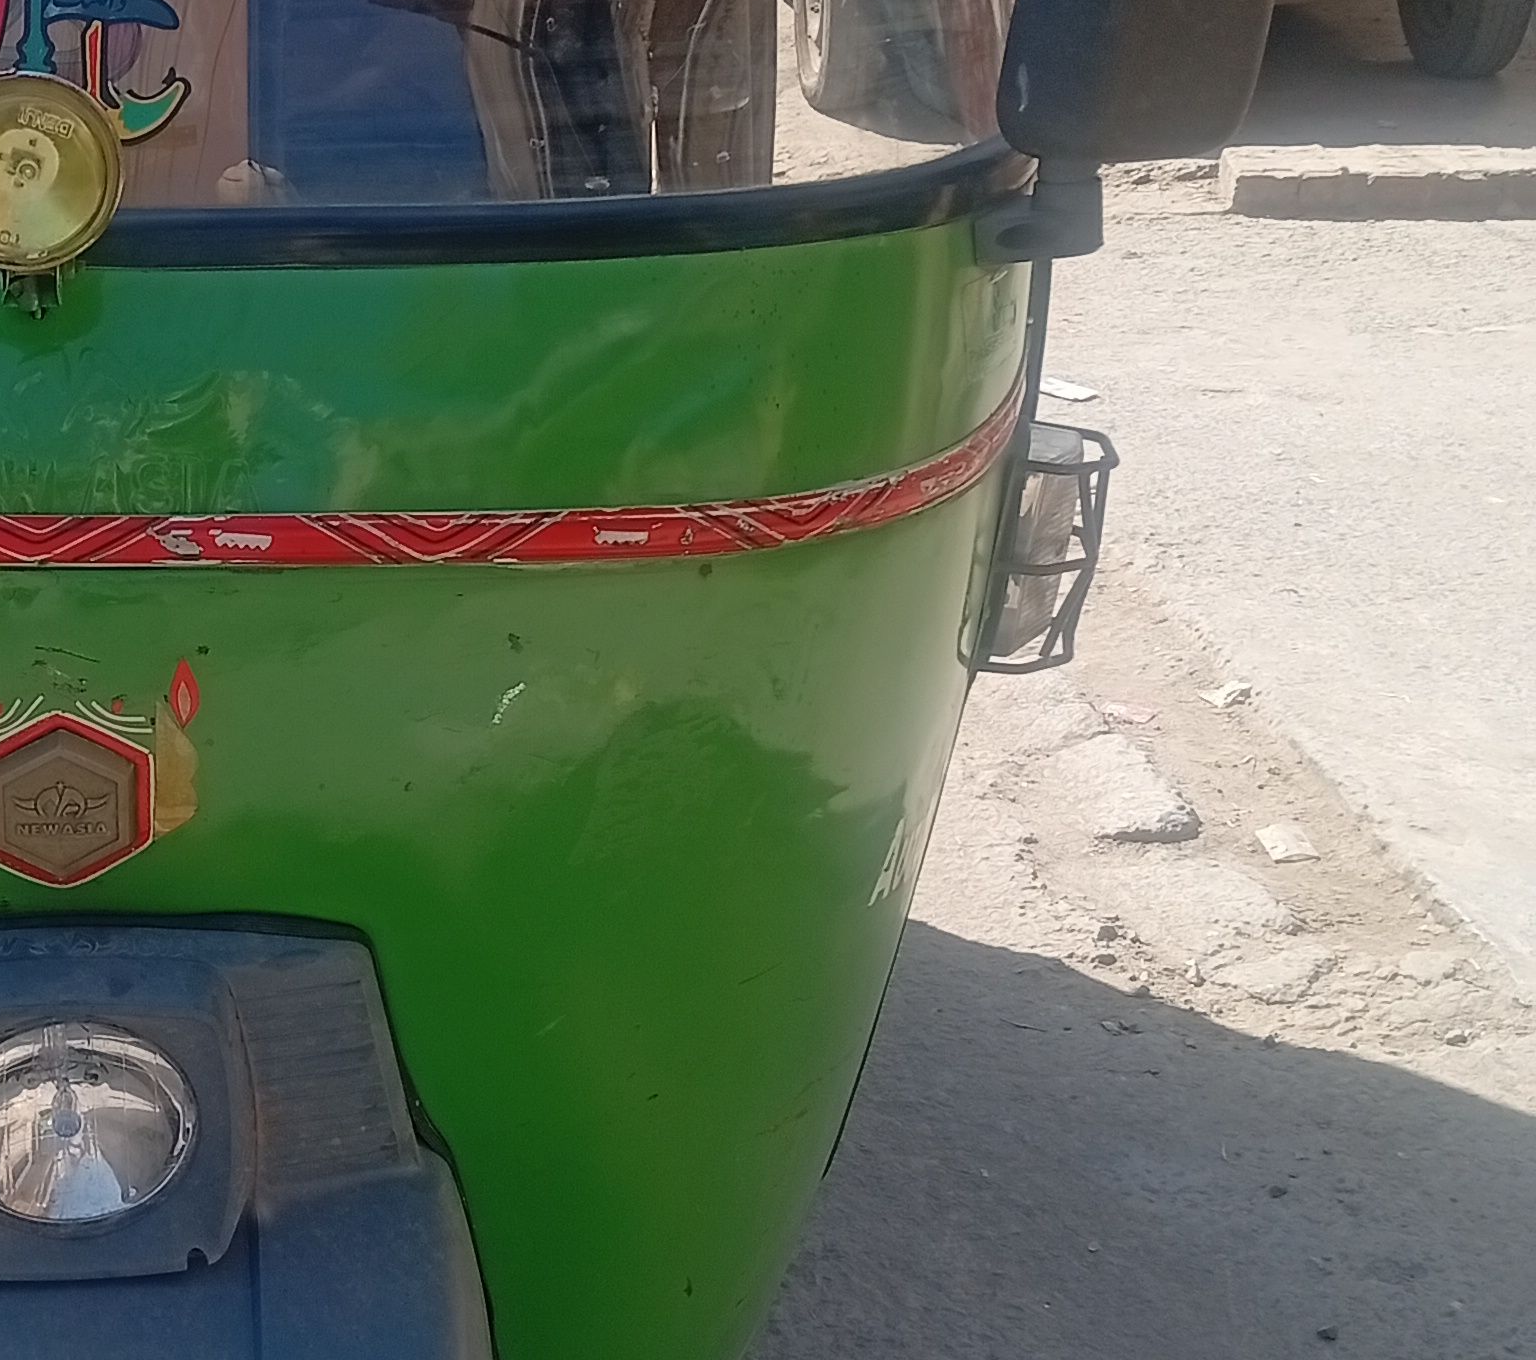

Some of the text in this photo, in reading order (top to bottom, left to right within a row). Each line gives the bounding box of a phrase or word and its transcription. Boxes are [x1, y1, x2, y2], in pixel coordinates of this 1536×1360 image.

[79, 455, 262, 513] ASIA
[15, 821, 108, 836] NEW ASIA
